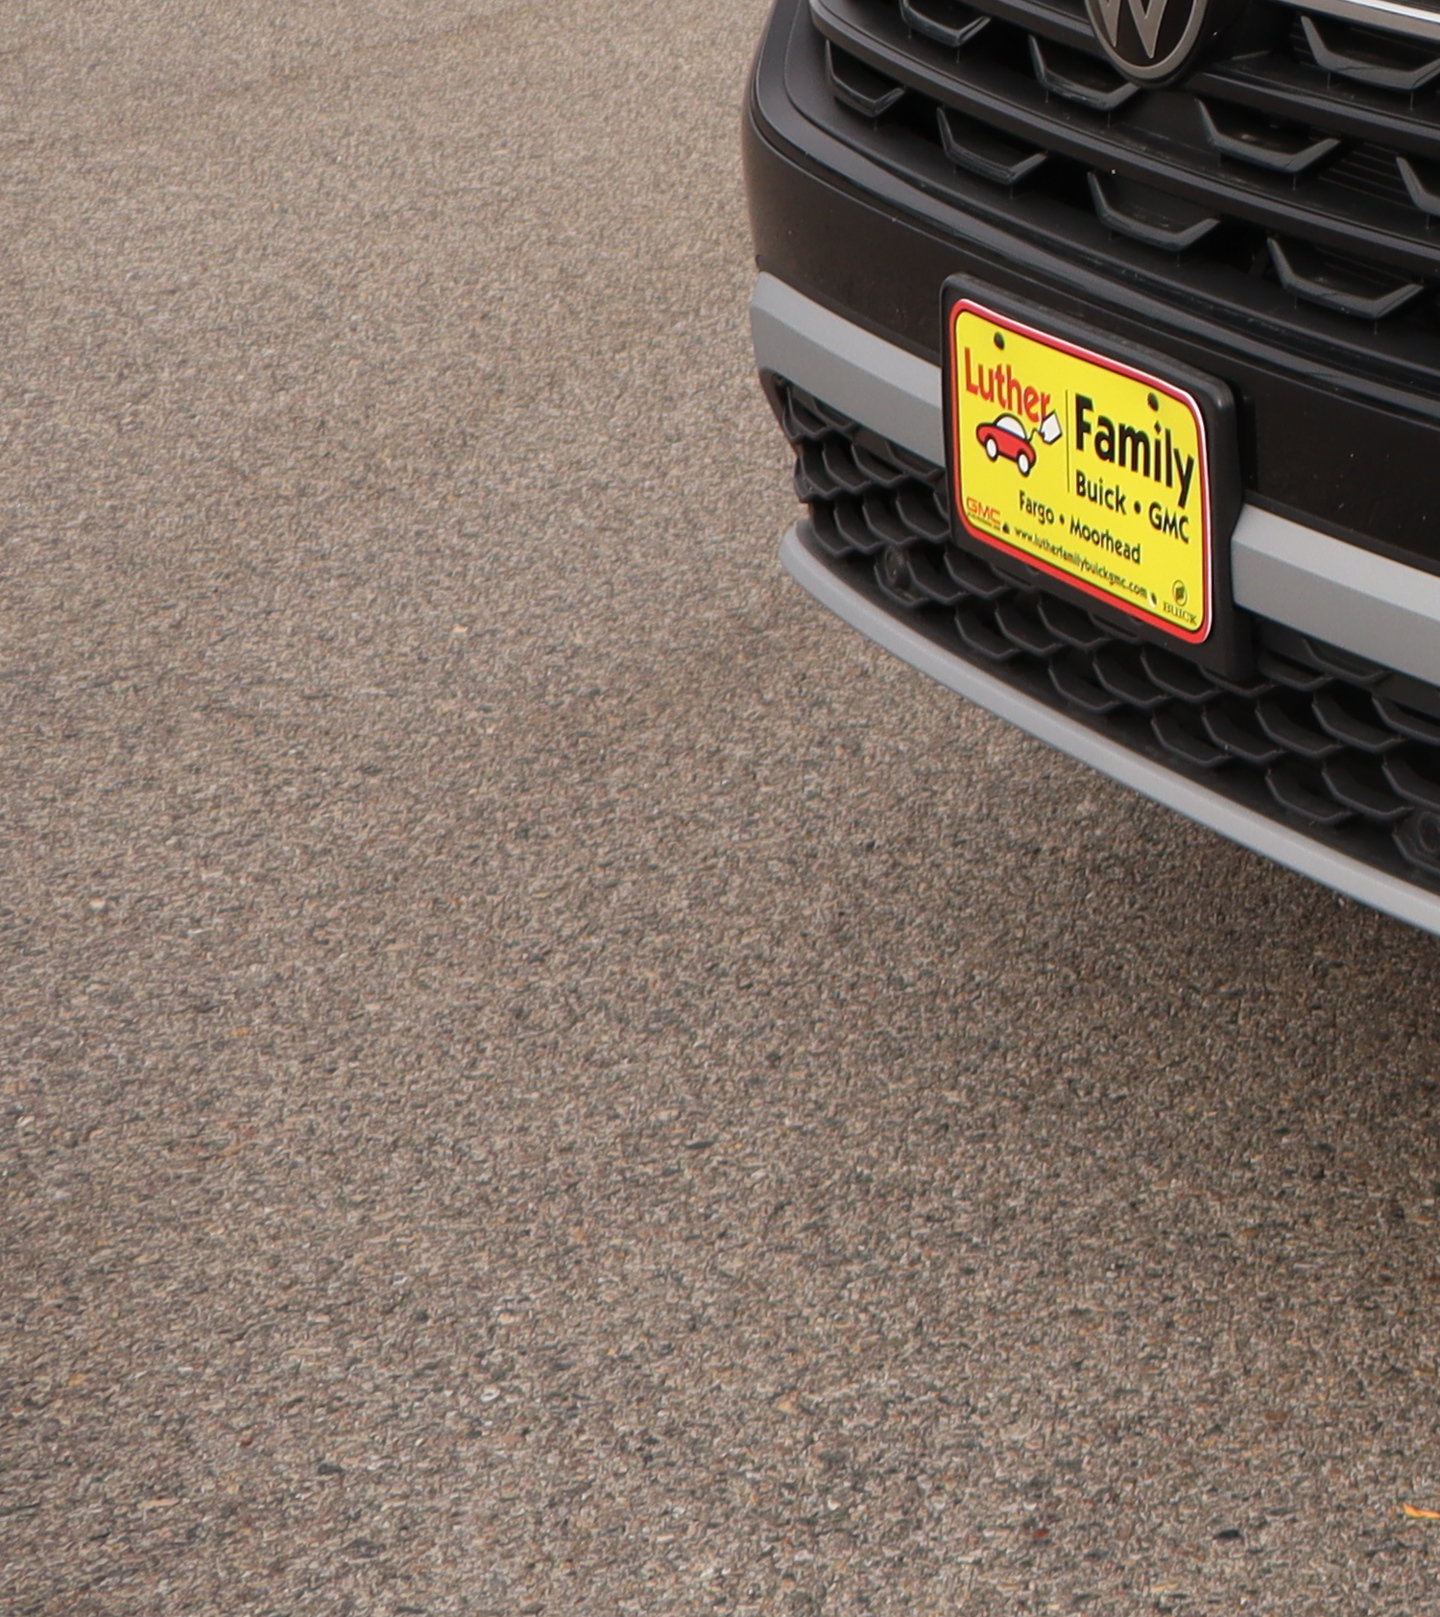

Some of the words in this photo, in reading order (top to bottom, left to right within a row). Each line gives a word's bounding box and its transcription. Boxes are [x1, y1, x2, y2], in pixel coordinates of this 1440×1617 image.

[964, 347, 1051, 422] Luther
[1075, 394, 1195, 509] Family
[966, 496, 1001, 525] GMC
[1019, 489, 1055, 525] Fargo
[1069, 515, 1141, 564] Moorhead
[1076, 470, 1127, 515] Buick
[1148, 501, 1190, 544] GMC
[1163, 601, 1197, 625] BUICK
